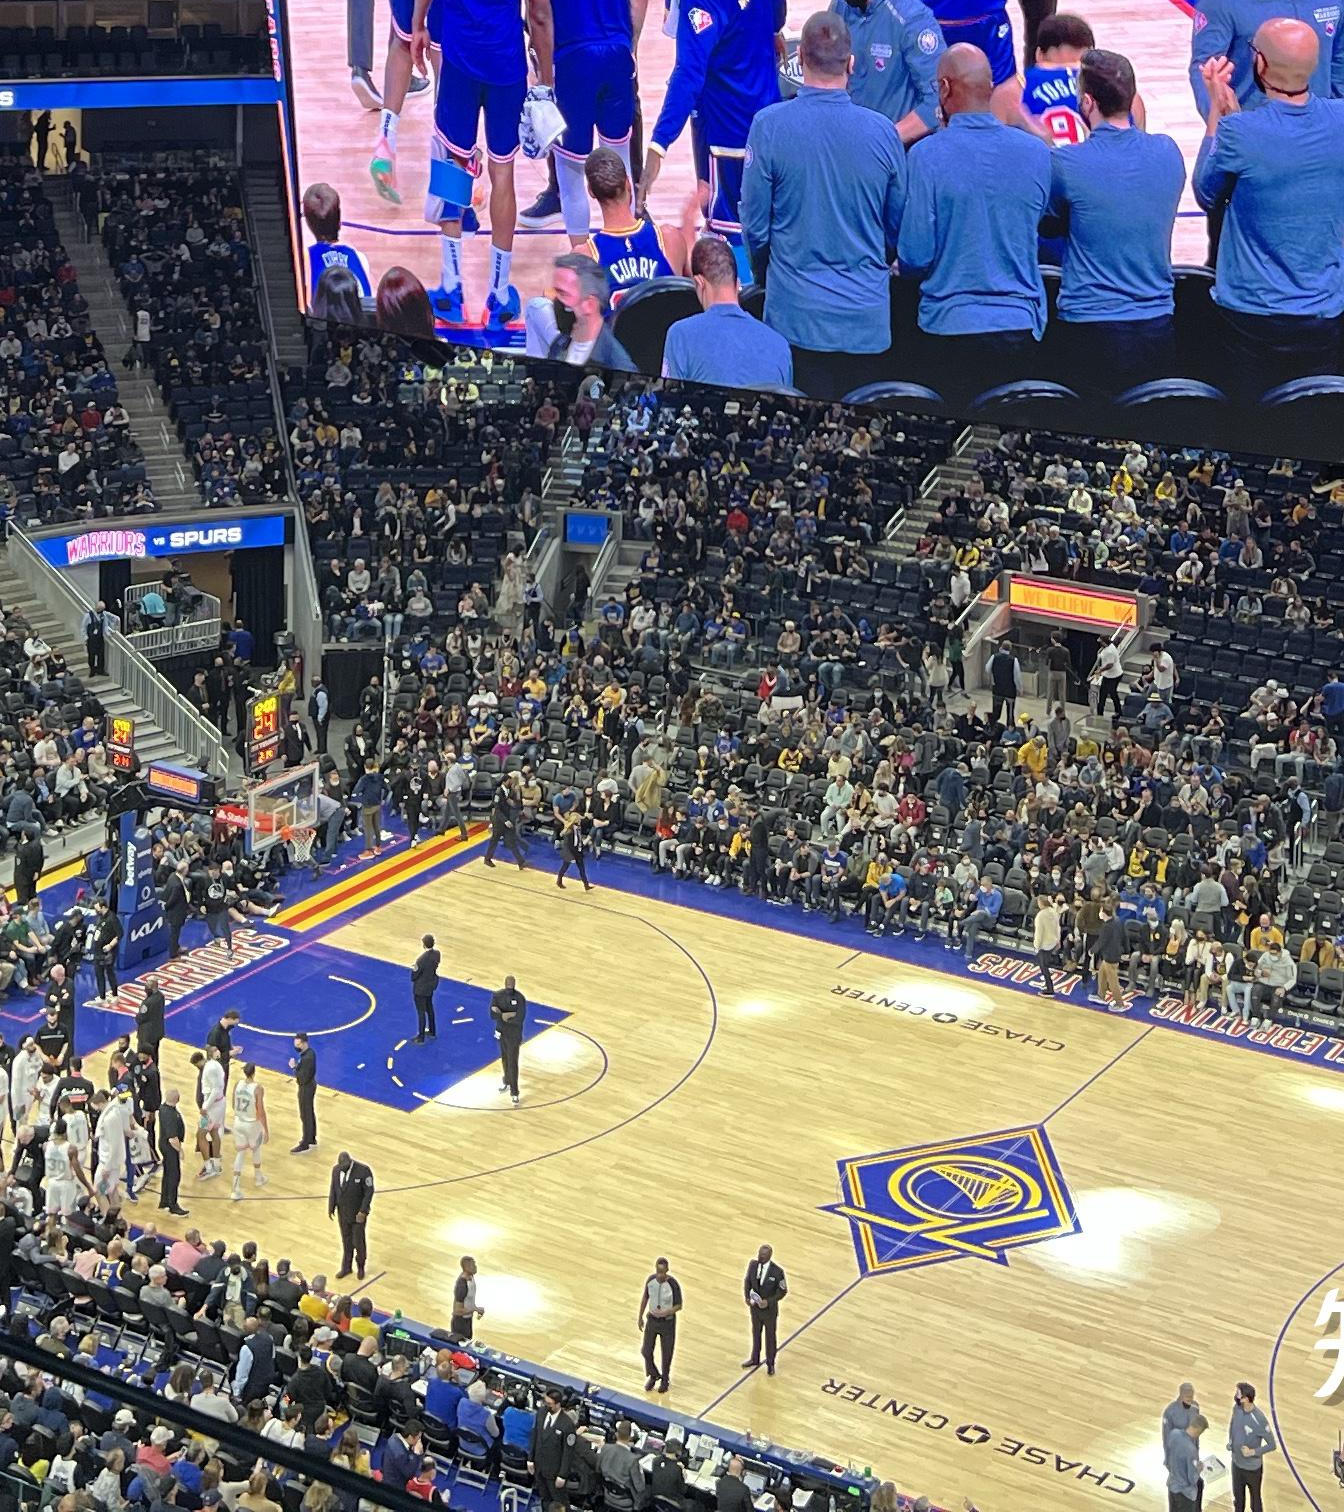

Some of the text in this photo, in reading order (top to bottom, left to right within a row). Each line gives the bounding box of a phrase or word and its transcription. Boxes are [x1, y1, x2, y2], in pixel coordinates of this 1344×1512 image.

[609, 259, 659, 285] CURRY
[66, 529, 147, 565] WARRIORS
[169, 526, 243, 547] SPURS
[830, 983, 1066, 1053] CHASE CENTER
[820, 1377, 1137, 1494] CHASE CENTER
